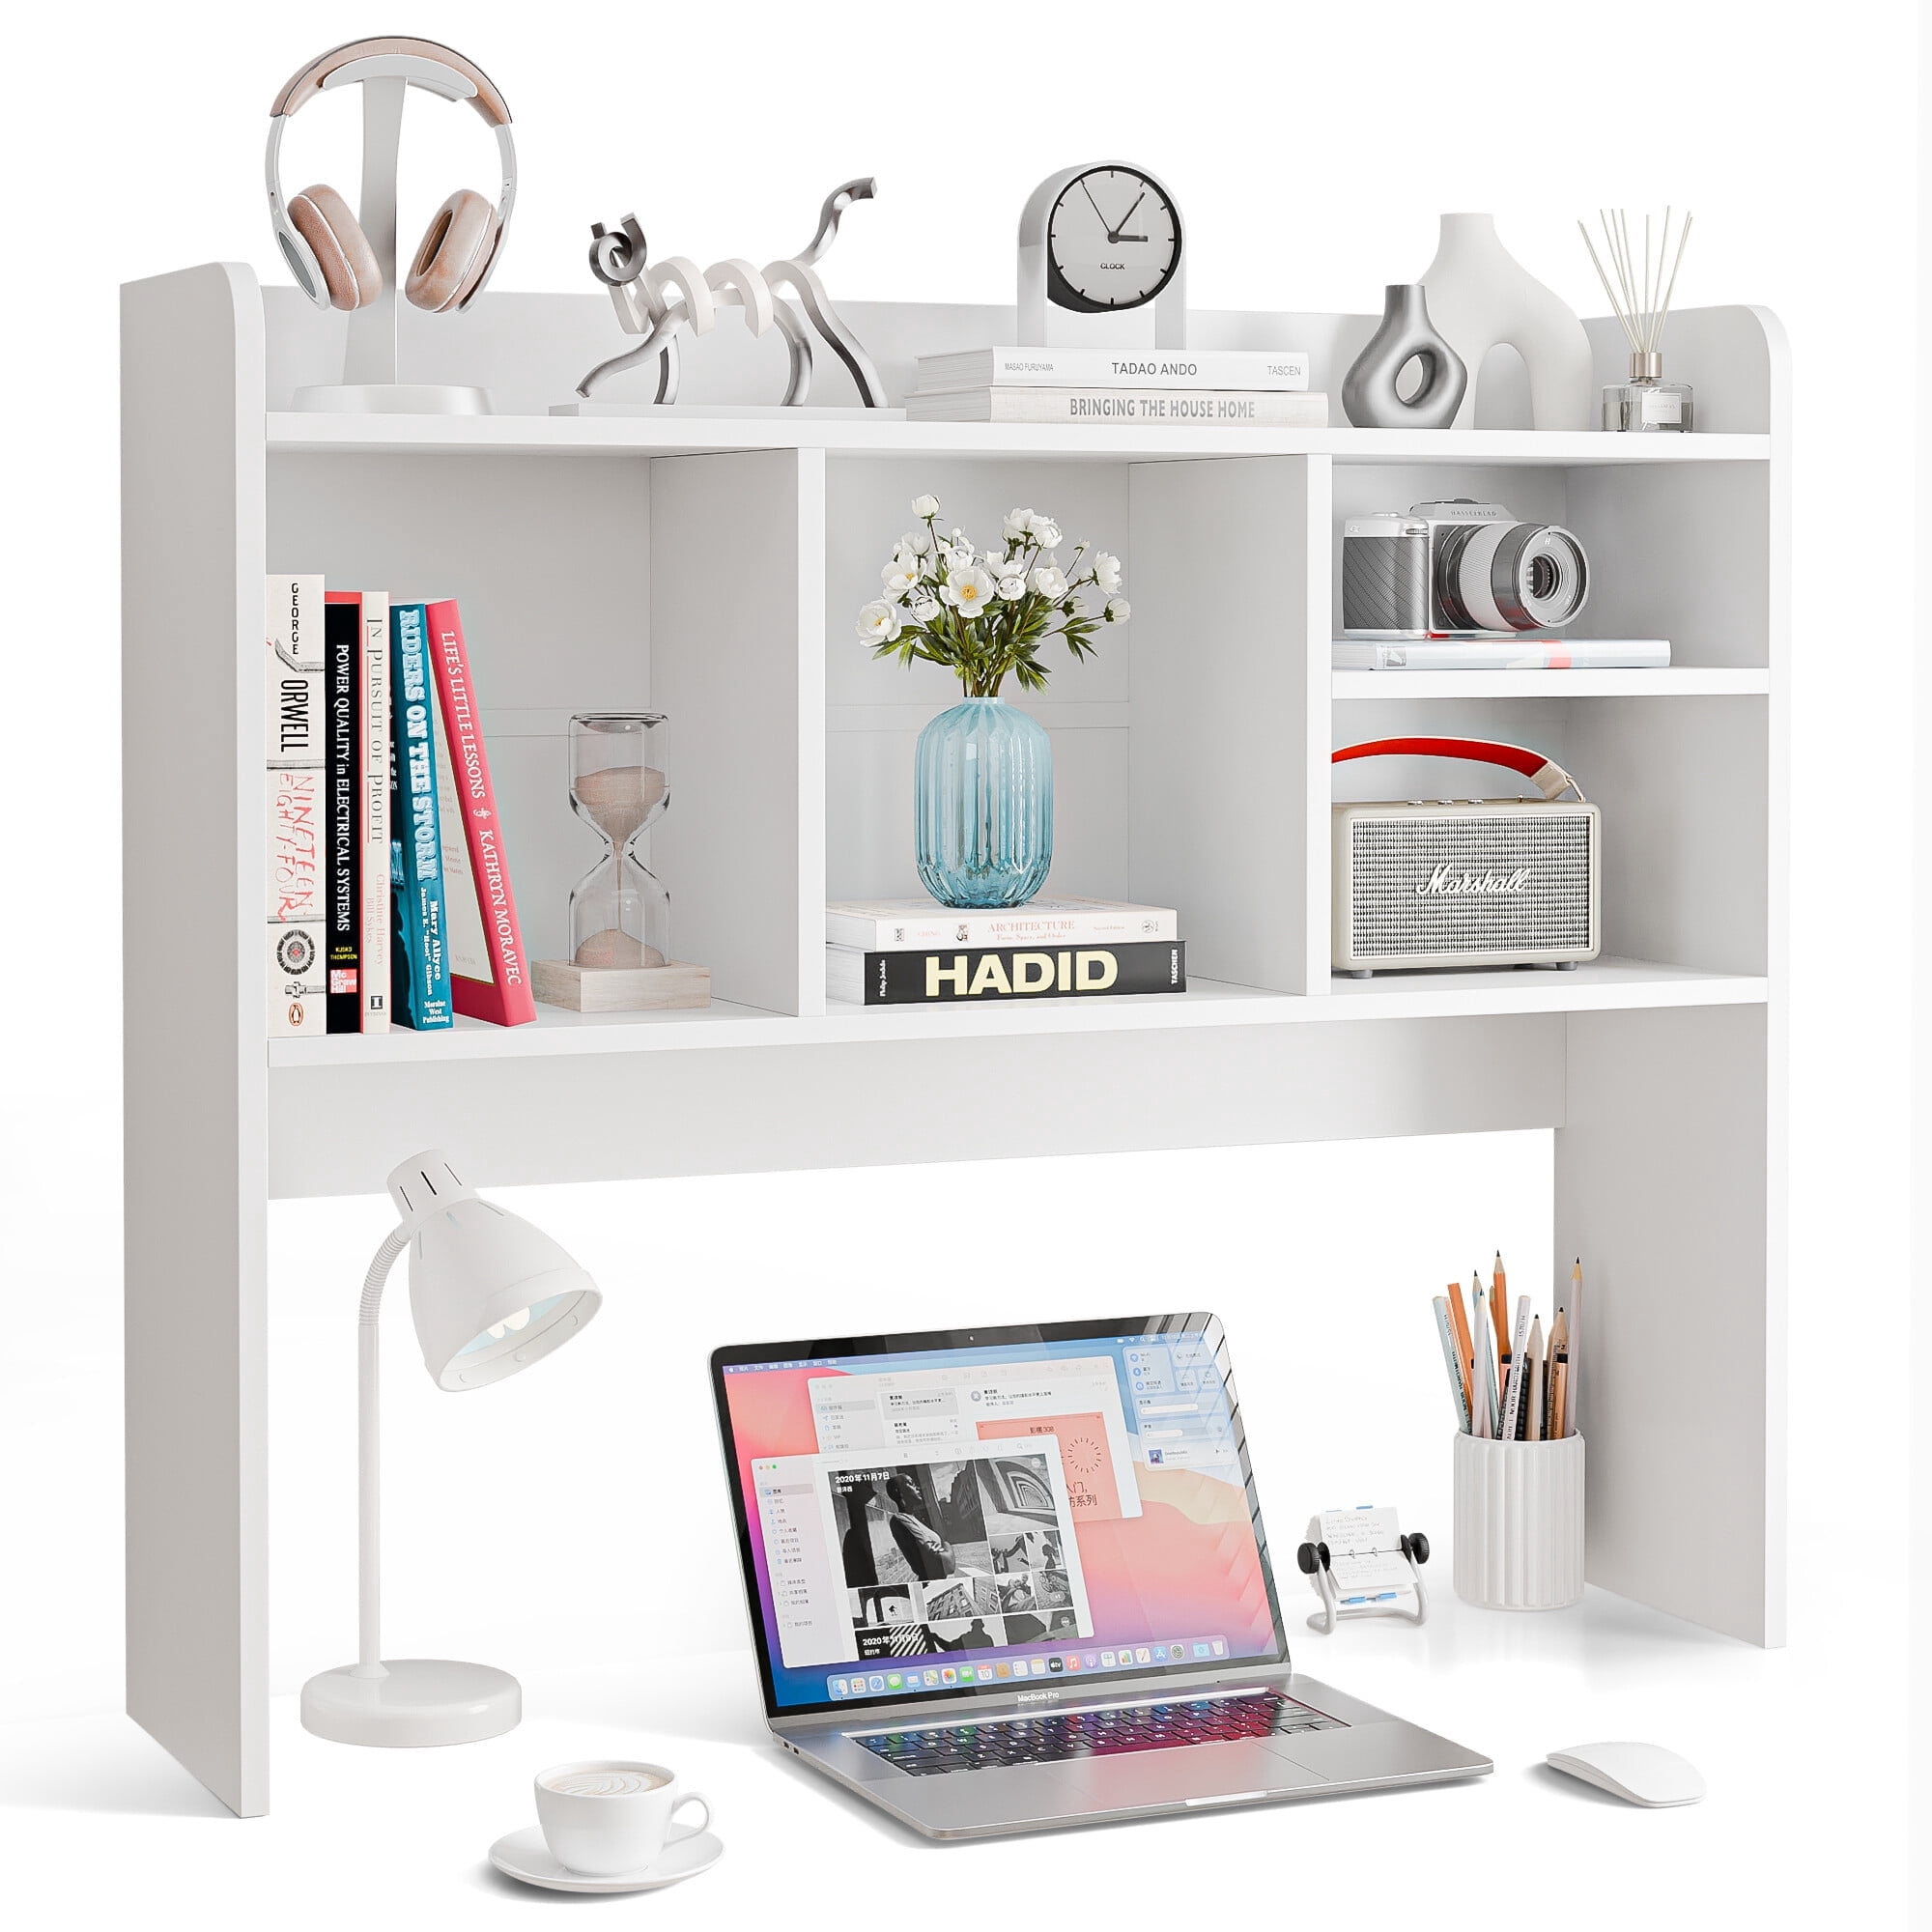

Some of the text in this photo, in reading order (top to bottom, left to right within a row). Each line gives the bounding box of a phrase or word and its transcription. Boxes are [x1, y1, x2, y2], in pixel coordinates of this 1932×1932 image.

[1005, 362, 1054, 372] MASAO FURUYAMA
[1112, 362, 1197, 376] TADAO ANDO
[1069, 398, 1255, 418] BRINGING THE HOUSE HOME
[291, 582, 299, 655] GEORGE
[281, 680, 309, 753] ORWELL
[367, 619, 384, 843] IN PURSUIT OF PROFIT
[399, 609, 438, 882] RIDERS ON THE STORM
[333, 644, 350, 932] POWER QUALITY in ELECTRICAL SYSTEMS
[440, 630, 523, 986] LIFE'S LITTLE LESSONS KATHRYN MORAVEC
[293, 774, 316, 910] NINETEEN
[1416, 863, 1531, 895] Marshall
[365, 918, 374, 944] Sykes
[374, 874, 385, 966] Christine Harvey
[430, 900, 439, 936] Mary
[988, 920, 1075, 933] ARCHITECTURE
[330, 970, 347, 979] Mc
[330, 978, 356, 986] Graw
[925, 950, 1119, 997] HADID
[423, 1015, 450, 1024] Publishing
[835, 1471, 890, 1484] 2020年11月7日
[1017, 1691, 1060, 1703] MacBook Pro
